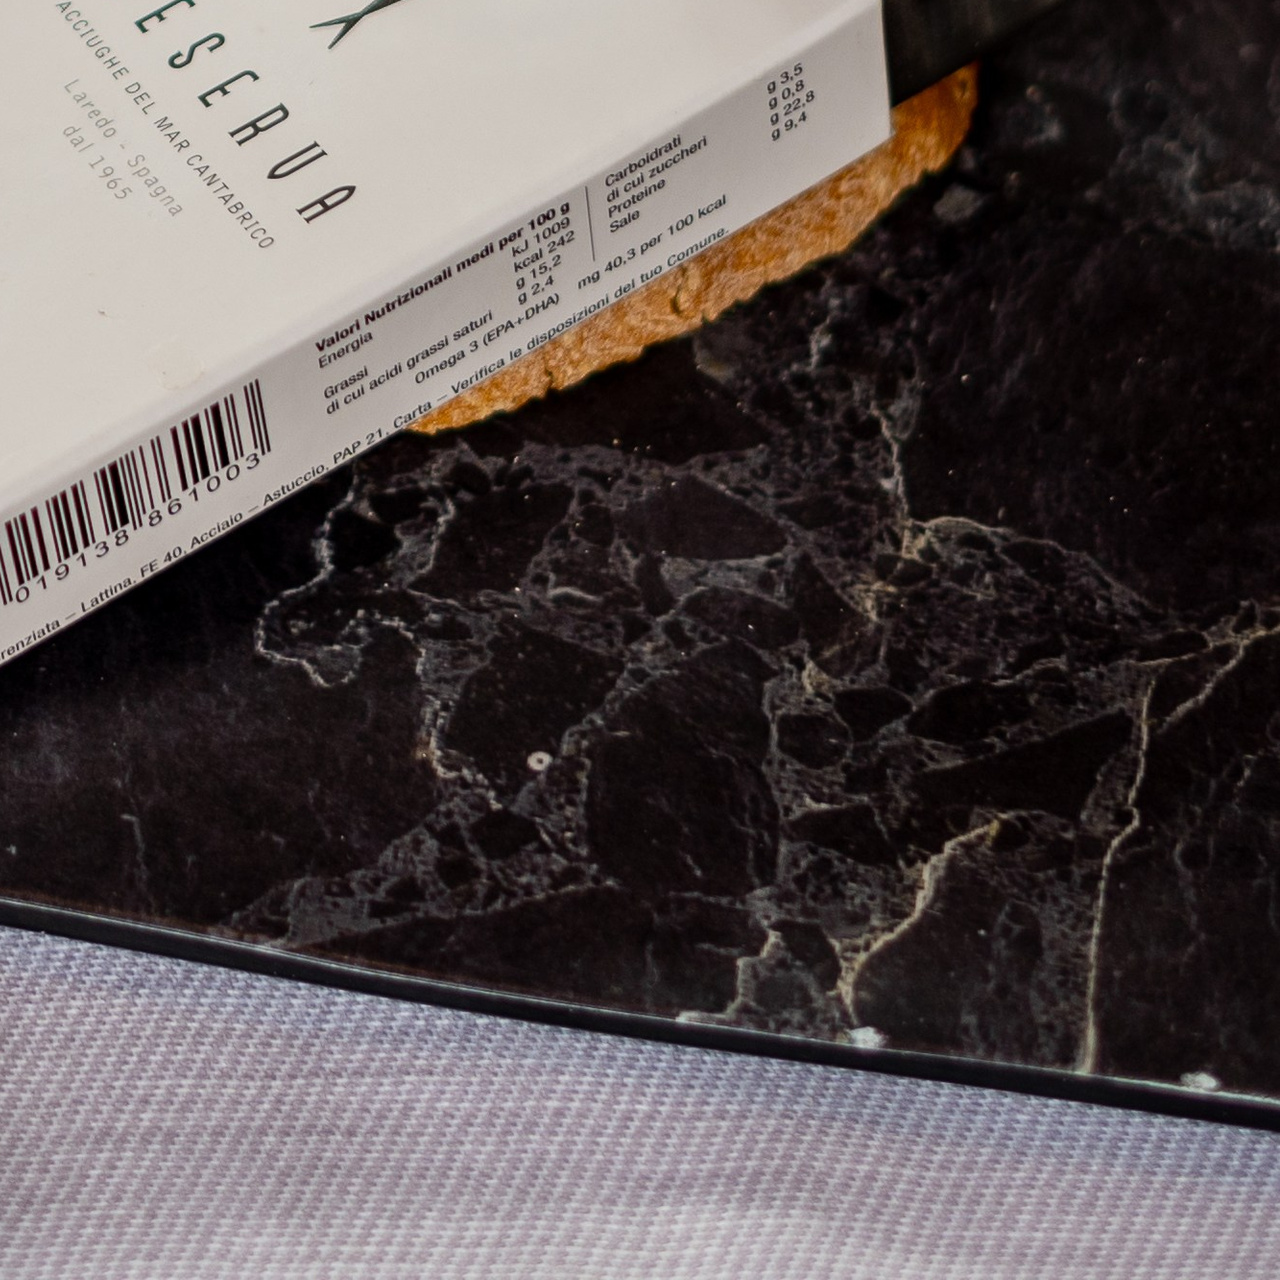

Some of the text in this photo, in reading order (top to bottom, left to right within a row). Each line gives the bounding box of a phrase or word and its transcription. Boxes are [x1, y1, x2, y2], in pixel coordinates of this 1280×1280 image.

[767, 62, 803, 95] g 3,5
[768, 79, 805, 111] g 0,8
[55, 1, 275, 249] ACCIUGHE DEL MAR CANTABRICO
[770, 90, 815, 126] g 22,8
[771, 111, 807, 142] g 9,4
[62, 126, 133, 200] dal 1965
[64, 78, 117, 139] Laredo
[126, 154, 183, 217] Spagna
[605, 134, 682, 187] Carboidrati
[606, 135, 707, 203] di cui zuccheri
[608, 179, 666, 219] Proteine
[511, 216, 571, 258] kJ 1009
[577, 194, 727, 290] mg 40,3 per 100 kcal
[609, 210, 640, 233] Sale
[513, 230, 575, 273] kcal 242
[516, 254, 562, 290] g 15,2
[315, 202, 570, 352] Valori Nutrizionali medi per 100 g
[517, 274, 554, 306] g 2,4
[318, 331, 374, 369] Energia
[415, 292, 560, 384] Omega 3 (EPA+DHA)
[323, 365, 369, 399] Grassi
[326, 310, 493, 415] di cui acidi grassi saturi
[80, 577, 139, 613] Lattina,
[140, 559, 158, 578] FE
[163, 546, 189, 563] 40,
[190, 512, 243, 549] Acciaio
[263, 464, 331, 507] Astuccio,
[333, 440, 361, 465] PAP
[365, 427, 391, 446] 21,
[393, 401, 433, 429] Carta
[451, 358, 506, 394] Verifica
[509, 348, 522, 361] le
[525, 293, 611, 356] disposizioni
[616, 278, 636, 299] del
[639, 265, 663, 284] tuo
[667, 227, 731, 267] Comune.
[14, 523, 131, 606] 019138
[146, 448, 260, 531] 861003
